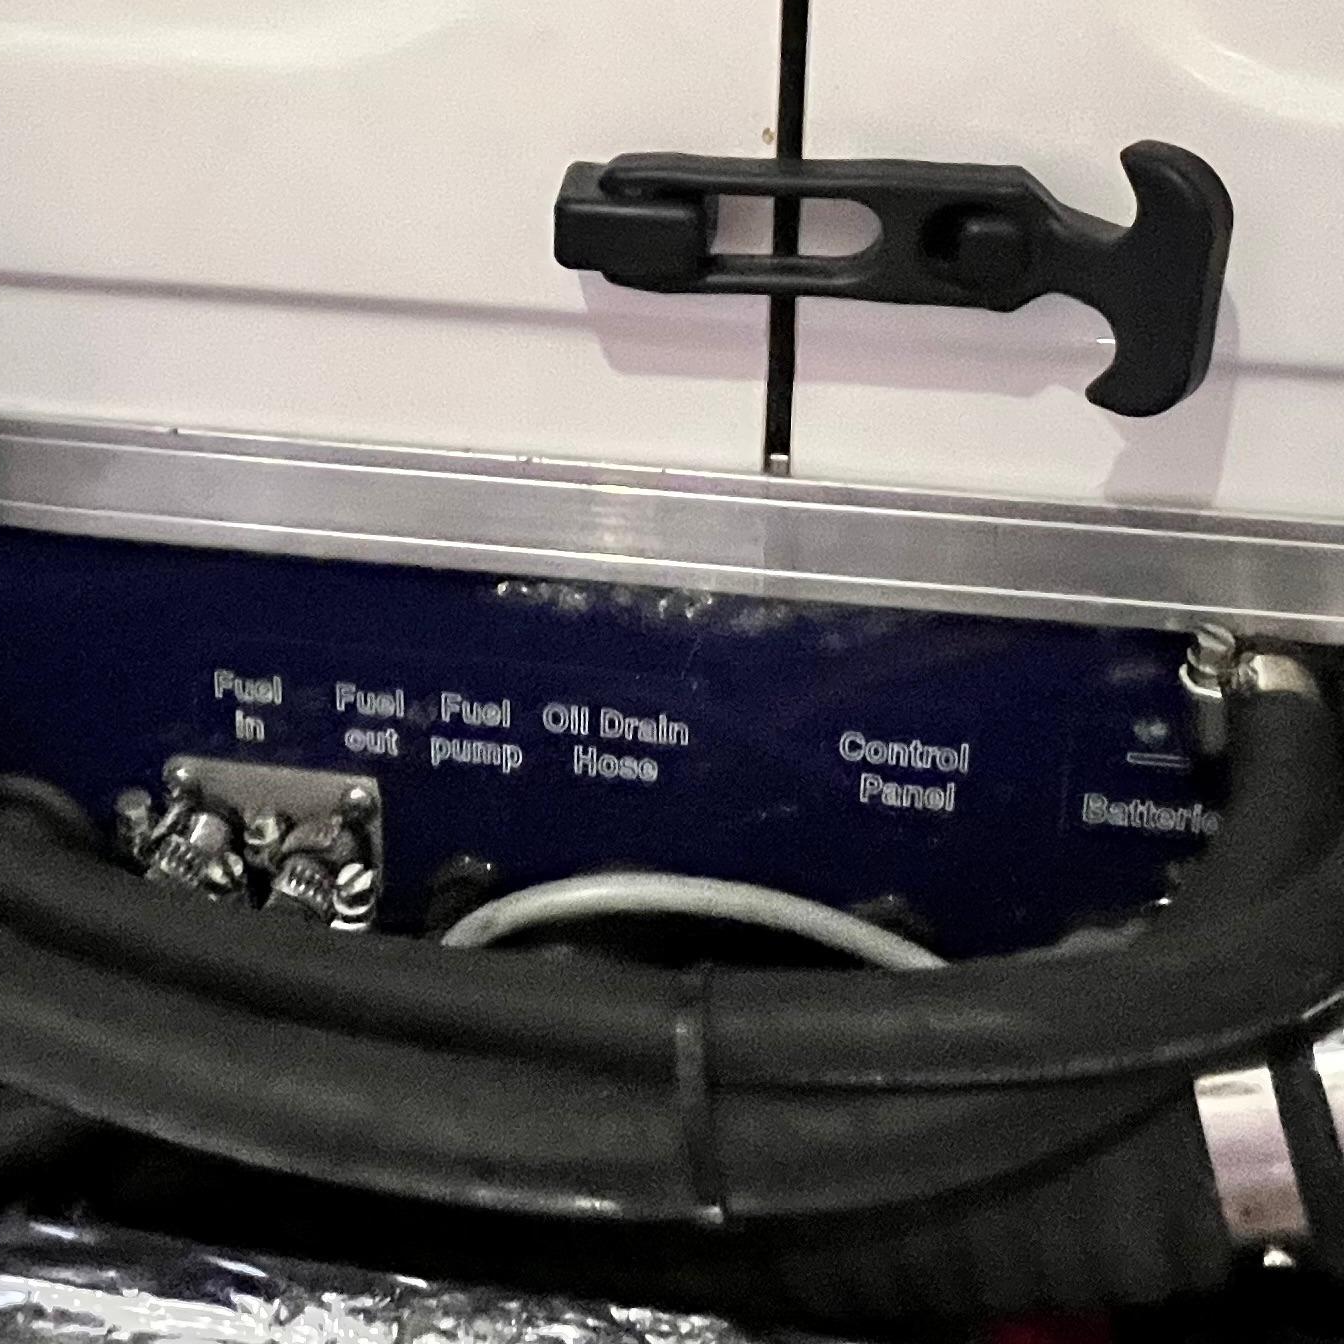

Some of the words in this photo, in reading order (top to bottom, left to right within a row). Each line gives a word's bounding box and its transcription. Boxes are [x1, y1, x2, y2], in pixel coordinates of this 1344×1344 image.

[213, 669, 283, 706] Fuel
[335, 682, 405, 719] Fuel
[440, 692, 512, 729] Fuel
[542, 701, 590, 736] Oil
[599, 708, 690, 747] Drain
[344, 726, 400, 756] out
[429, 734, 523, 774] pump
[838, 731, 971, 774] Control
[572, 747, 659, 783] Hose
[859, 773, 956, 813] Panel
